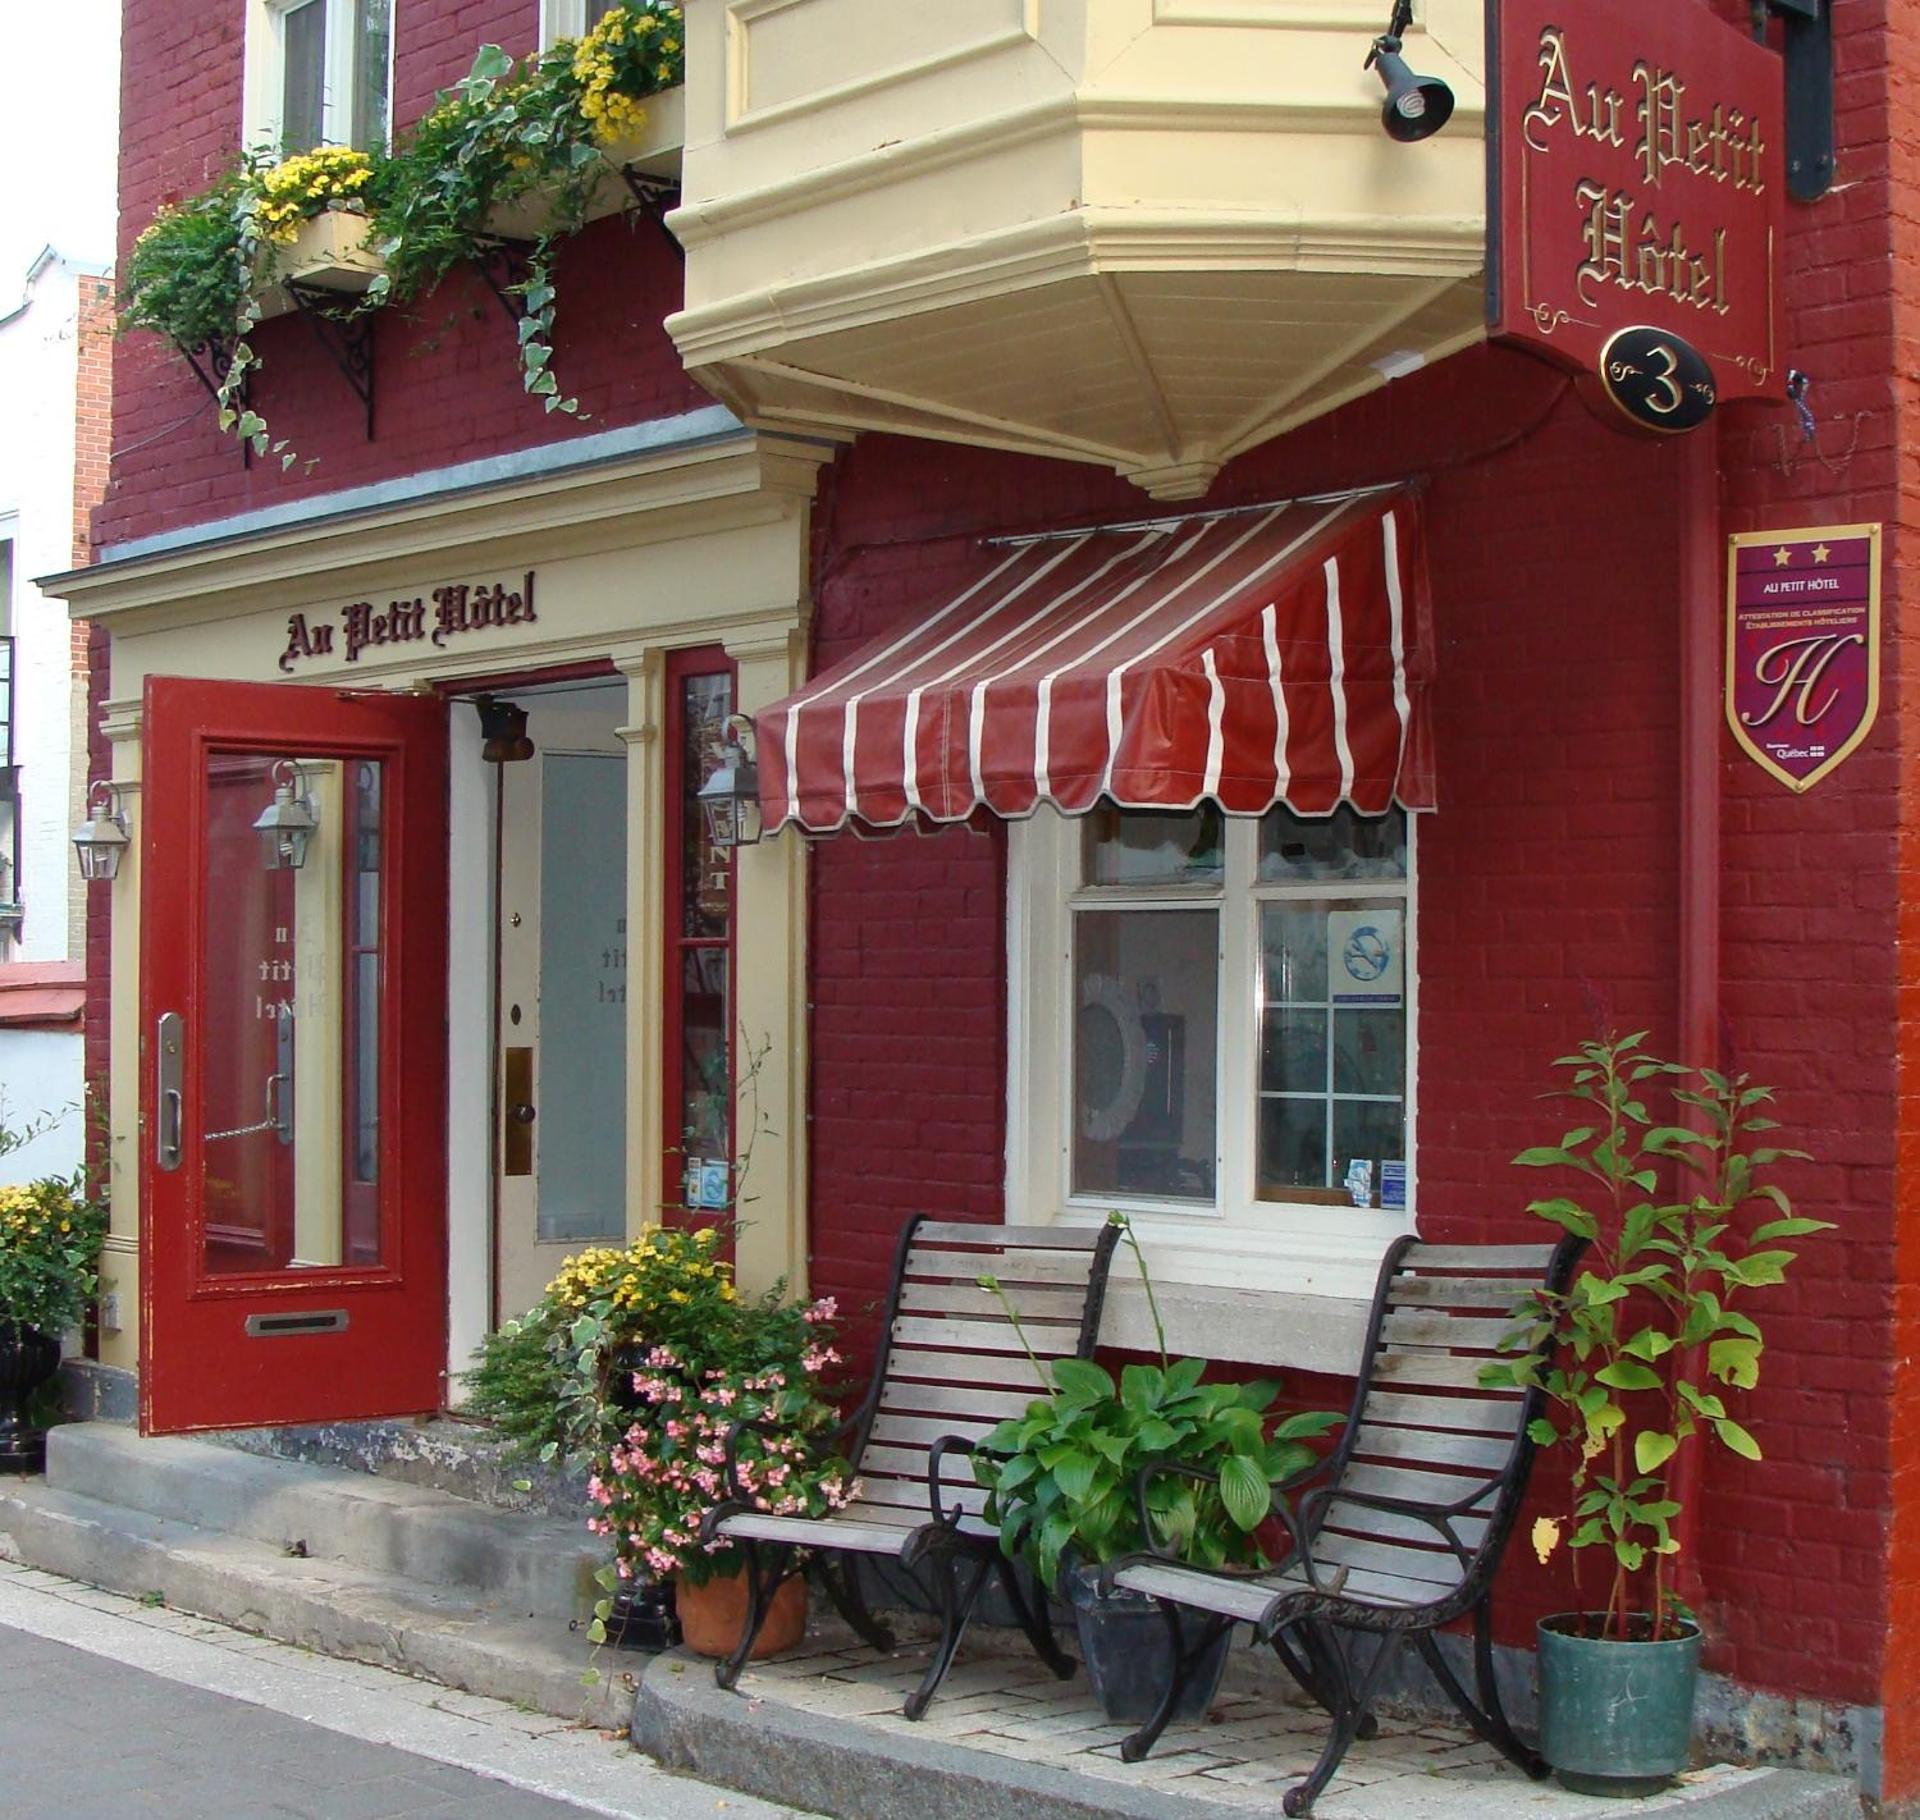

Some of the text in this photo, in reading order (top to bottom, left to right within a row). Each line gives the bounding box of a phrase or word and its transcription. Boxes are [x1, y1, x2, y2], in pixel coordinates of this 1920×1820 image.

[1524, 26, 1765, 194] Au Petit
[1575, 177, 1729, 316] Hôtel
[1644, 345, 1682, 413] 3
[279, 571, 537, 672] Au Petit Hôtel
[1763, 578, 1840, 593] AU PETIT HÔTEL
[1741, 633, 1864, 726] H
[1776, 748, 1809, 759] Québec
